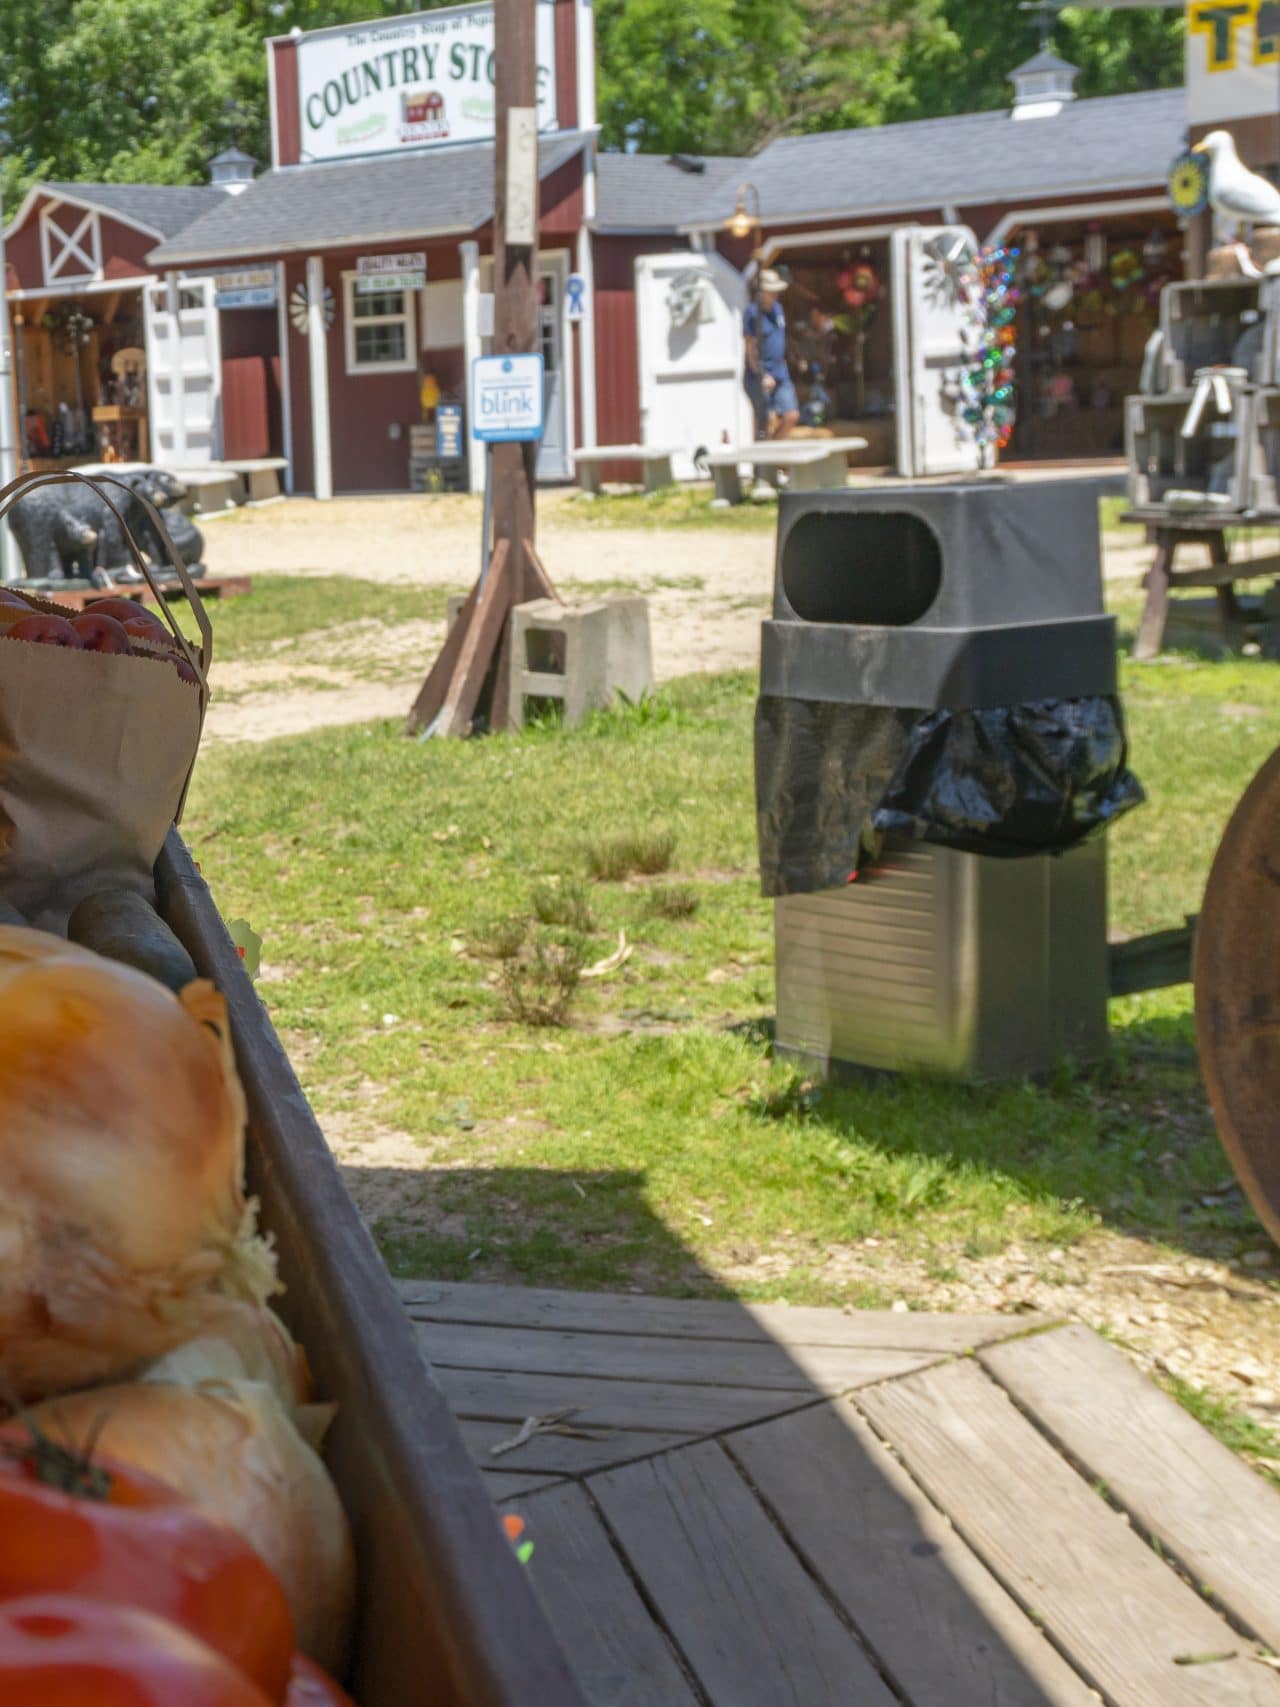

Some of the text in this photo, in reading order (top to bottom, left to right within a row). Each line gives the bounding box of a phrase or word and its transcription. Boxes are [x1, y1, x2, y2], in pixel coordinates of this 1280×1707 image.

[371, 28, 416, 43] Country
[306, 43, 439, 130] COUNTRY
[481, 391, 533, 415] blink
